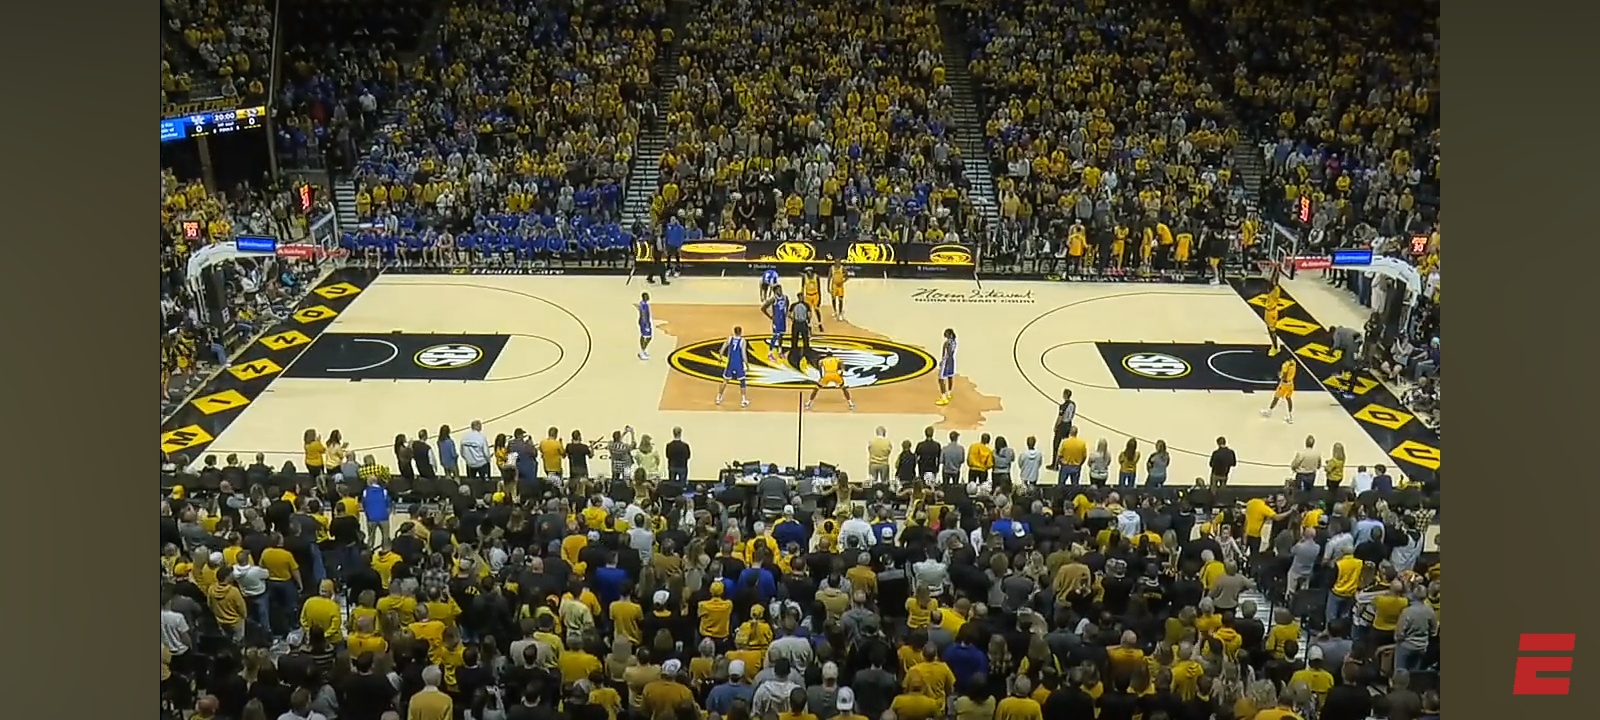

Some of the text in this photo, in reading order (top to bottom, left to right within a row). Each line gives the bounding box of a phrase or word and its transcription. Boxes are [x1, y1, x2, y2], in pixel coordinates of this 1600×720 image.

[214, 112, 235, 121] 20:00
[420, 346, 477, 367] SEC
[1127, 355, 1186, 376] SEC
